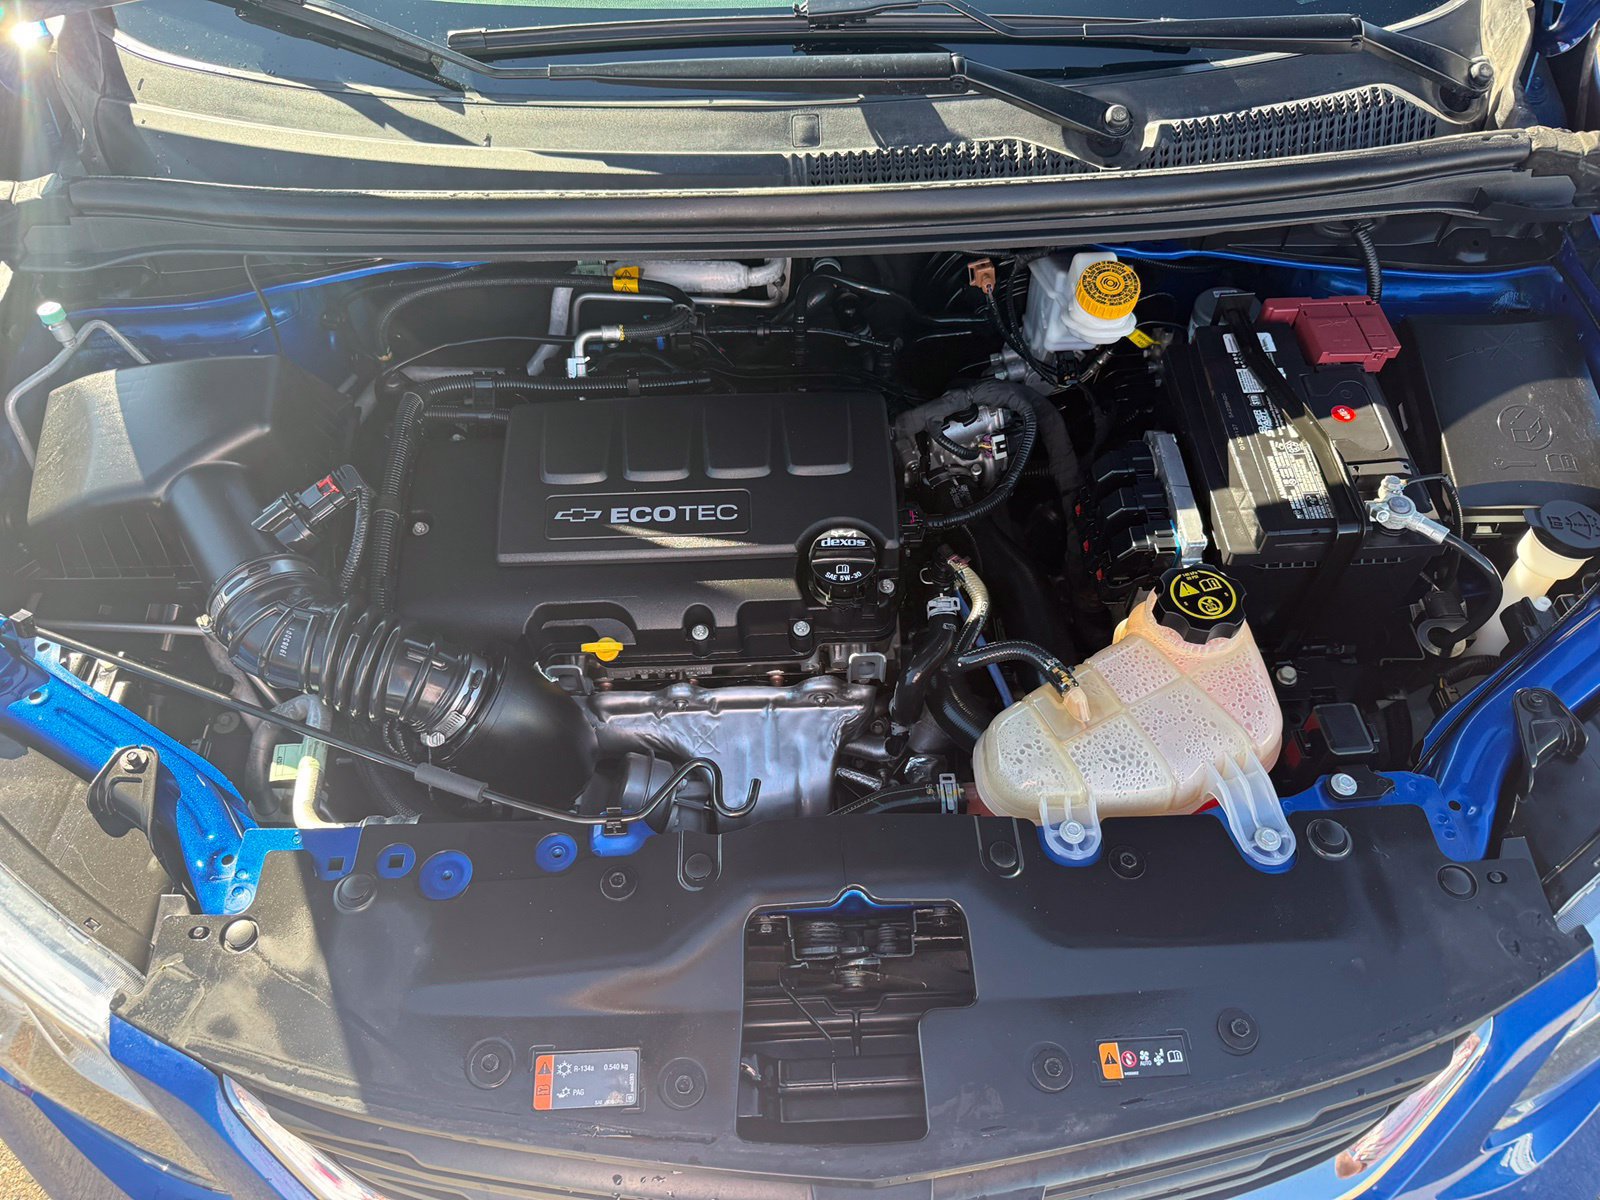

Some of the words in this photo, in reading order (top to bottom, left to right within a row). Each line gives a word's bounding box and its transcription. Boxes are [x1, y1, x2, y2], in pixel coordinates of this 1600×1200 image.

[610, 504, 738, 524] ECOTEC
[821, 538, 866, 547] dexos
[825, 572, 837, 580] SAE
[840, 571, 862, 581] 5W-30
